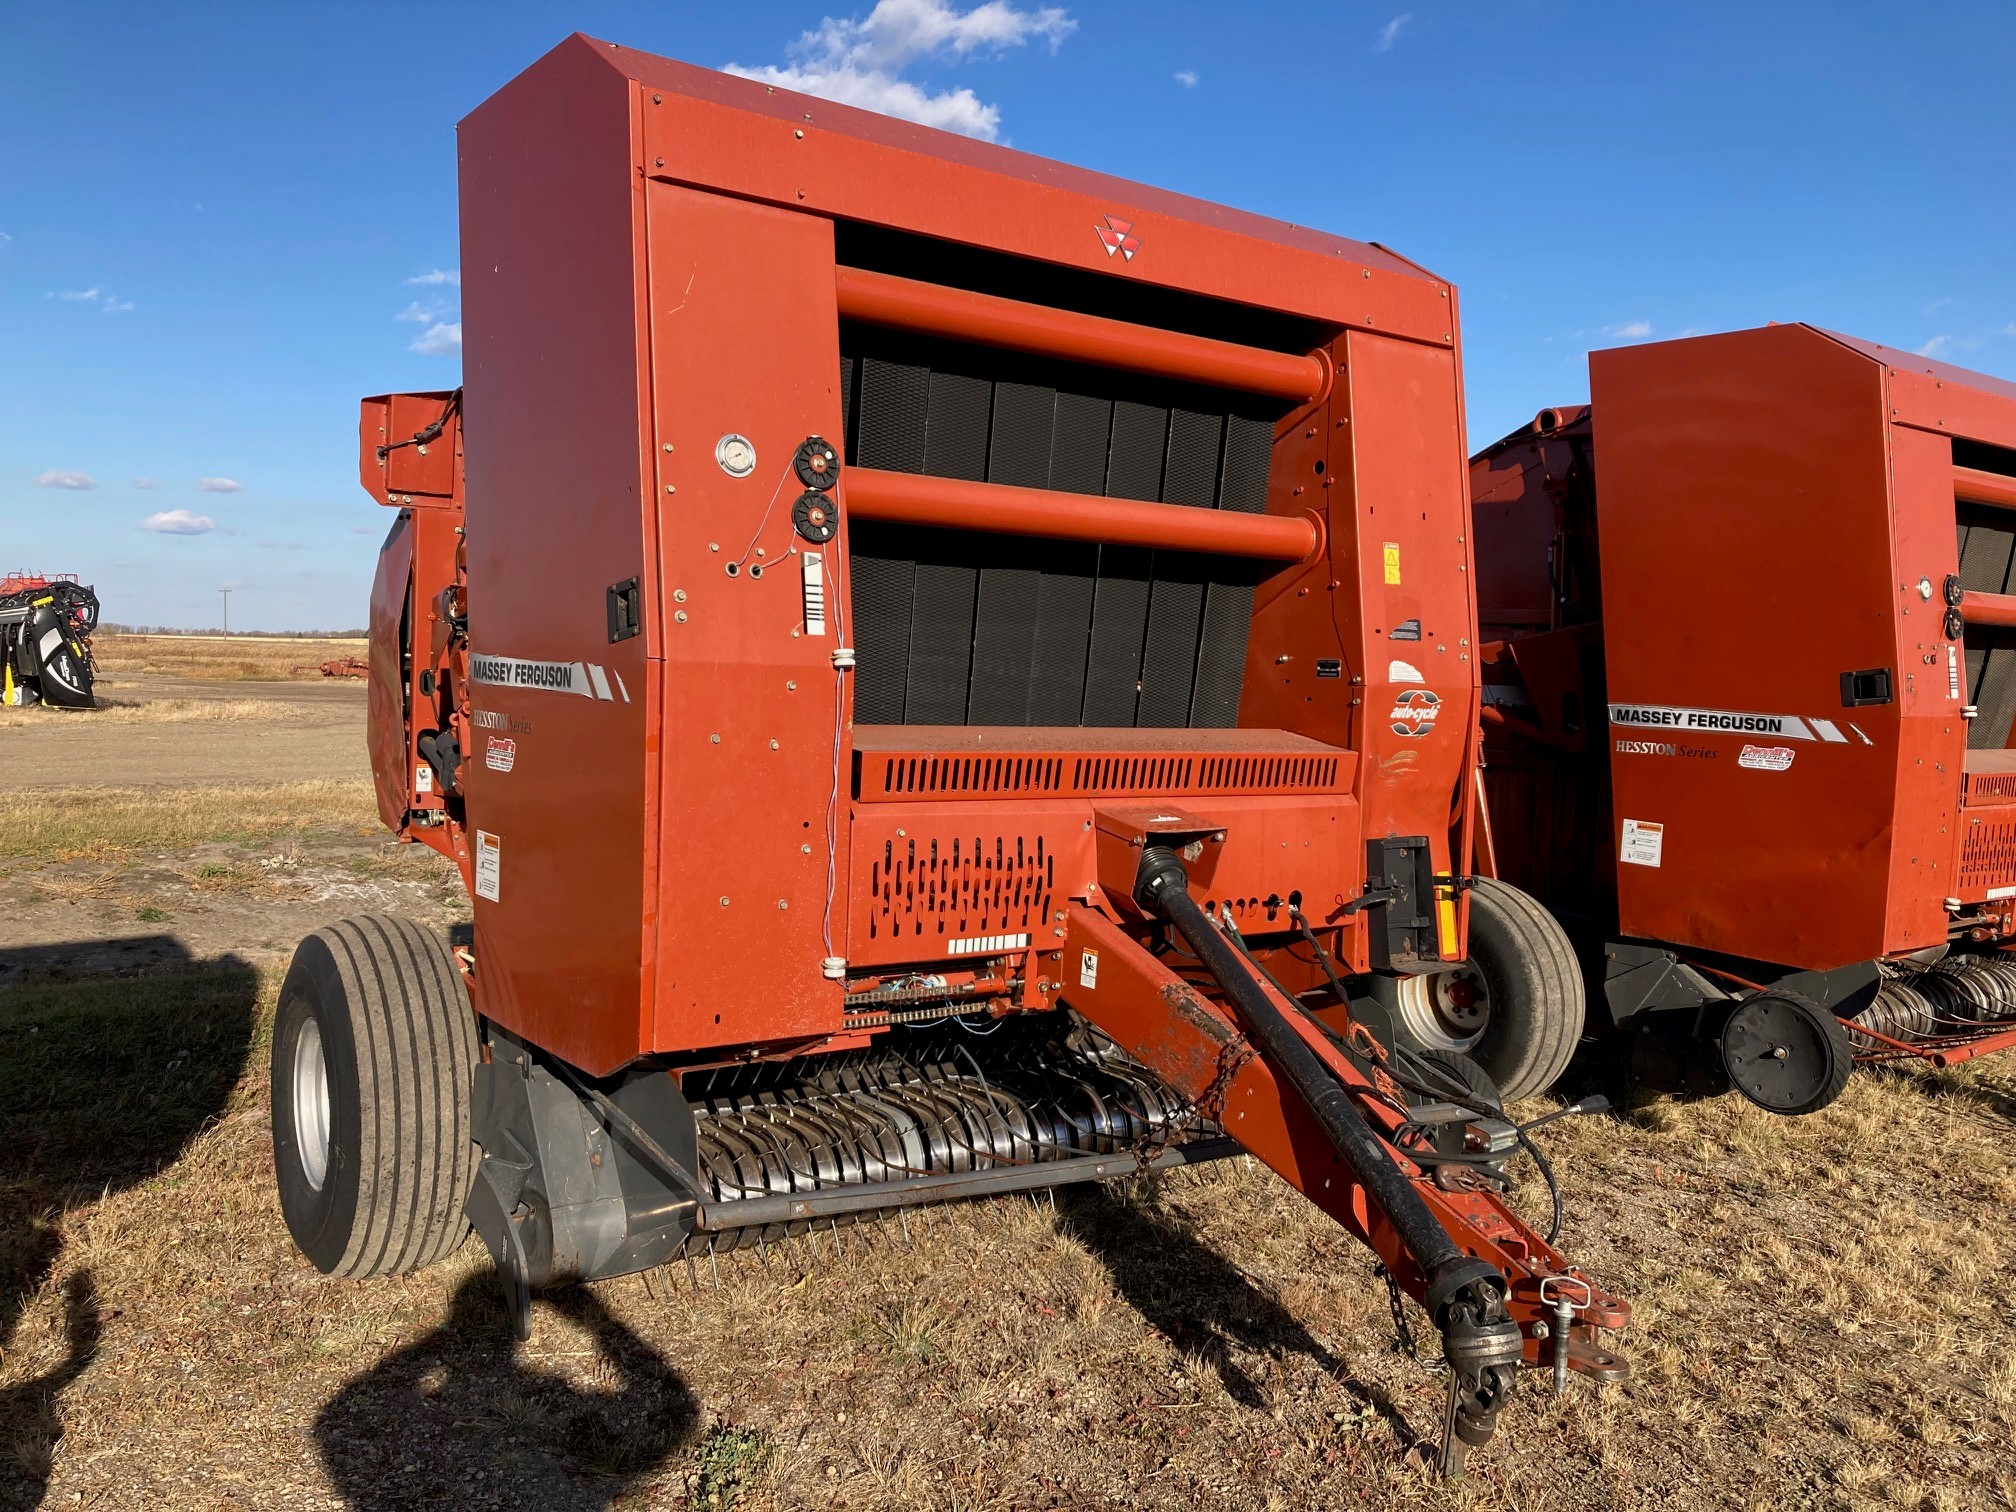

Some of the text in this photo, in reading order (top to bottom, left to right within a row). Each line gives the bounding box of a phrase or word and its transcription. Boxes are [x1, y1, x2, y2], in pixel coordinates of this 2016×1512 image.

[473, 660, 572, 688] MASSEY FERGUSON
[473, 709, 532, 734] HESSTON Series
[1616, 709, 1782, 732] MASSEY FERGUSON
[1616, 740, 1718, 760] HESSTON Series
